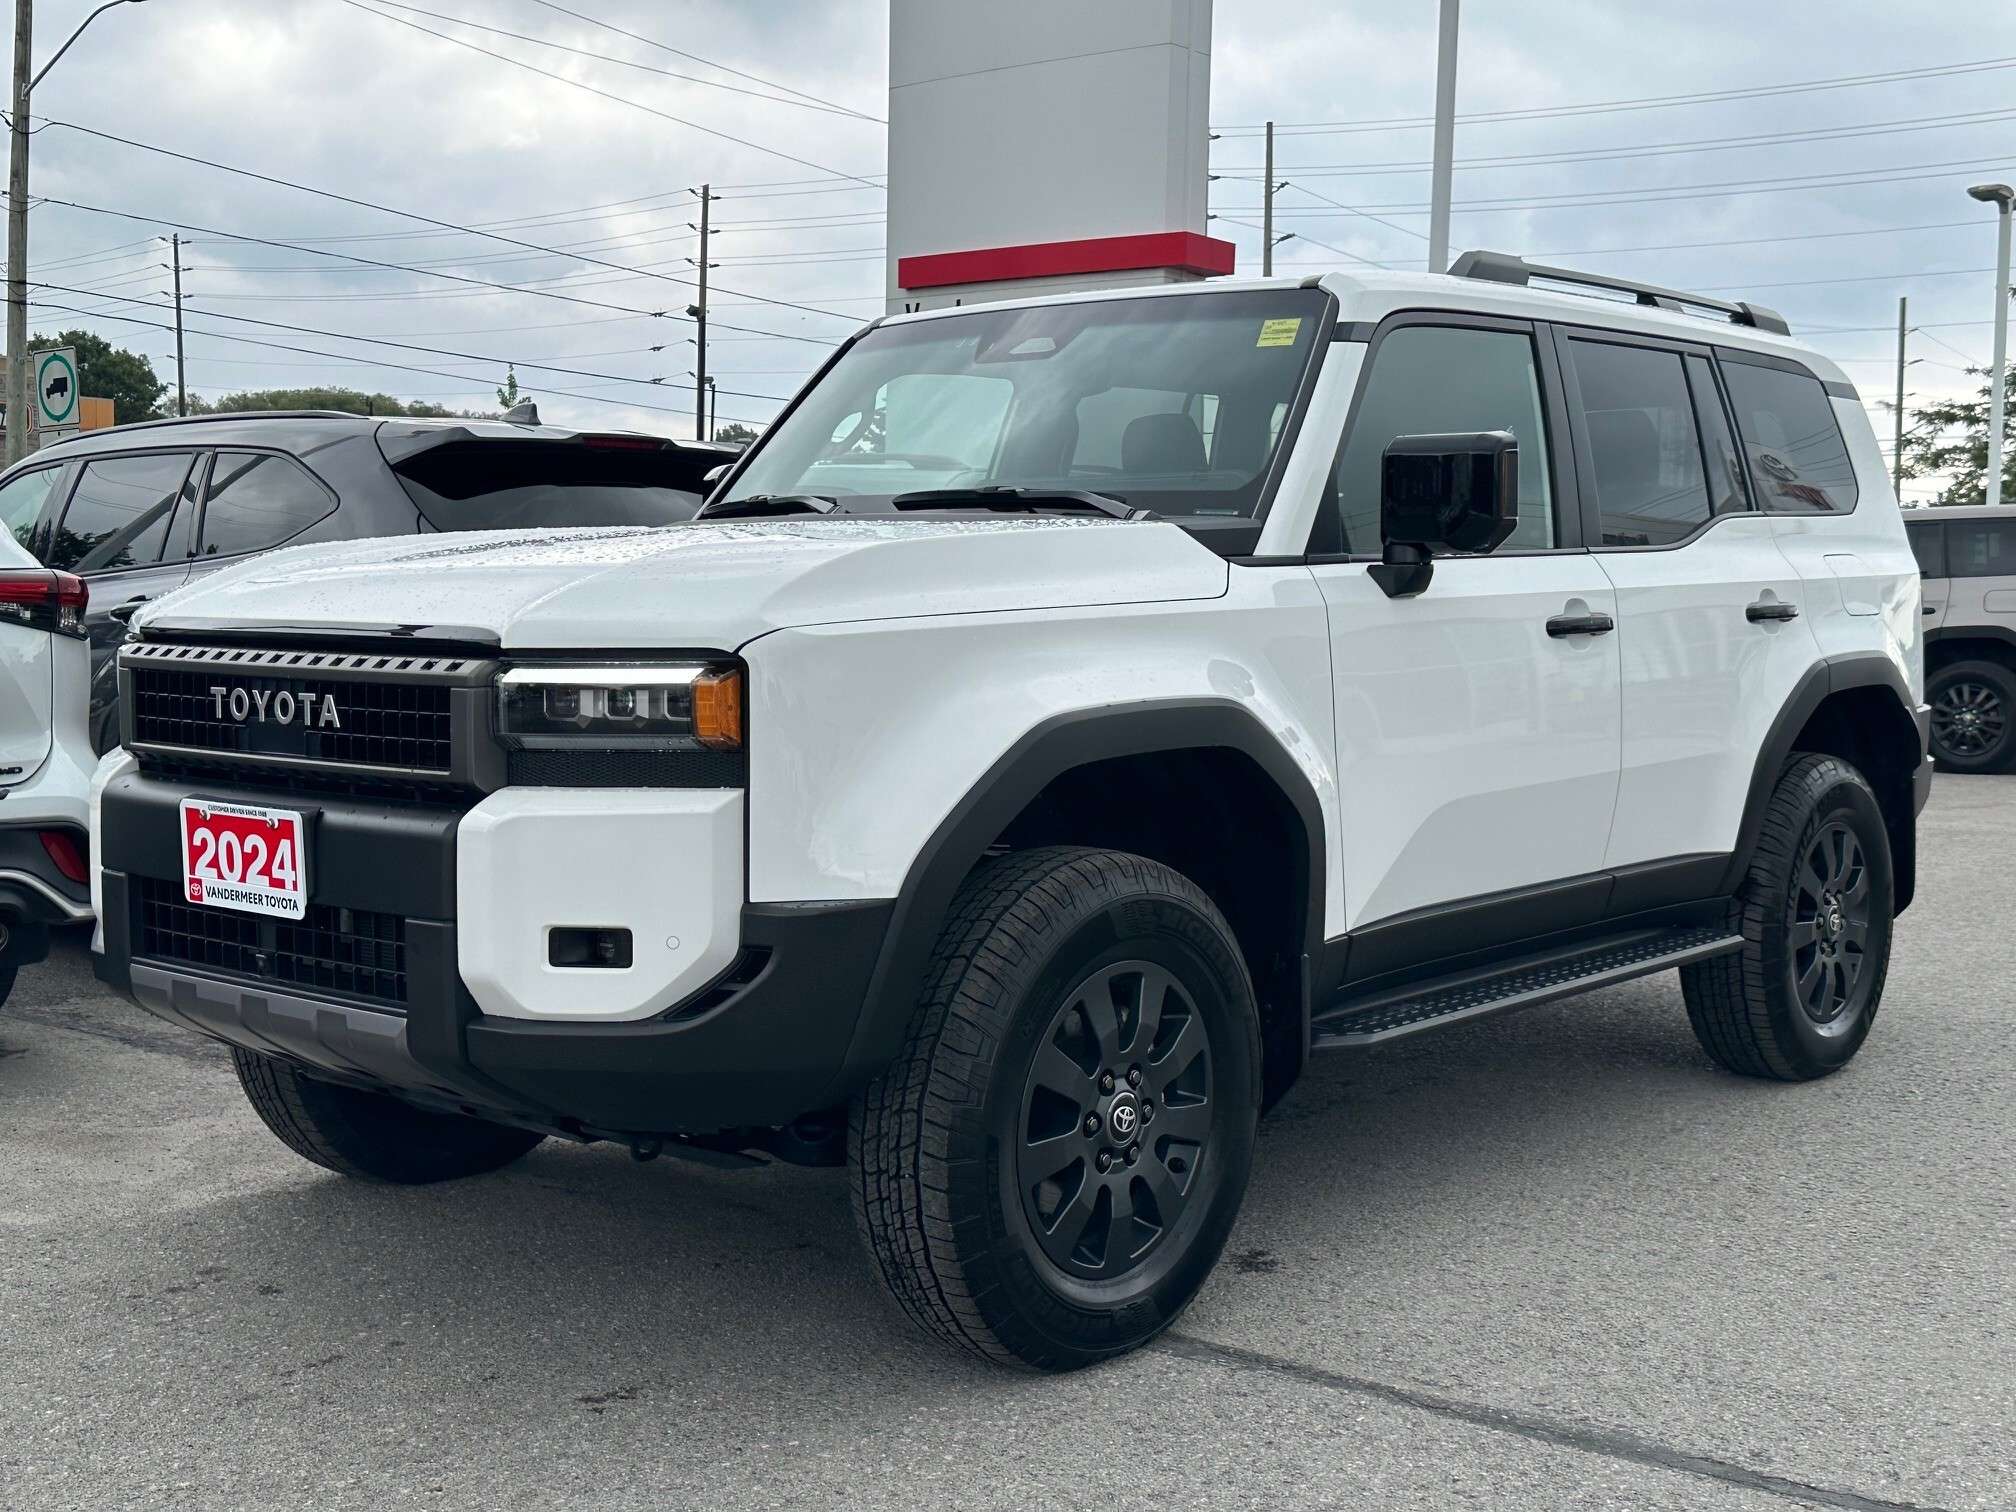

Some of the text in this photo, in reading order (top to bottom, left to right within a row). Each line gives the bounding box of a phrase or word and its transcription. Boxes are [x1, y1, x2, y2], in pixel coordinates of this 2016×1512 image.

[209, 686, 341, 729] TOYOTA
[193, 827, 296, 892] 2024
[205, 885, 299, 911] VANDERMEER TOYOTA
